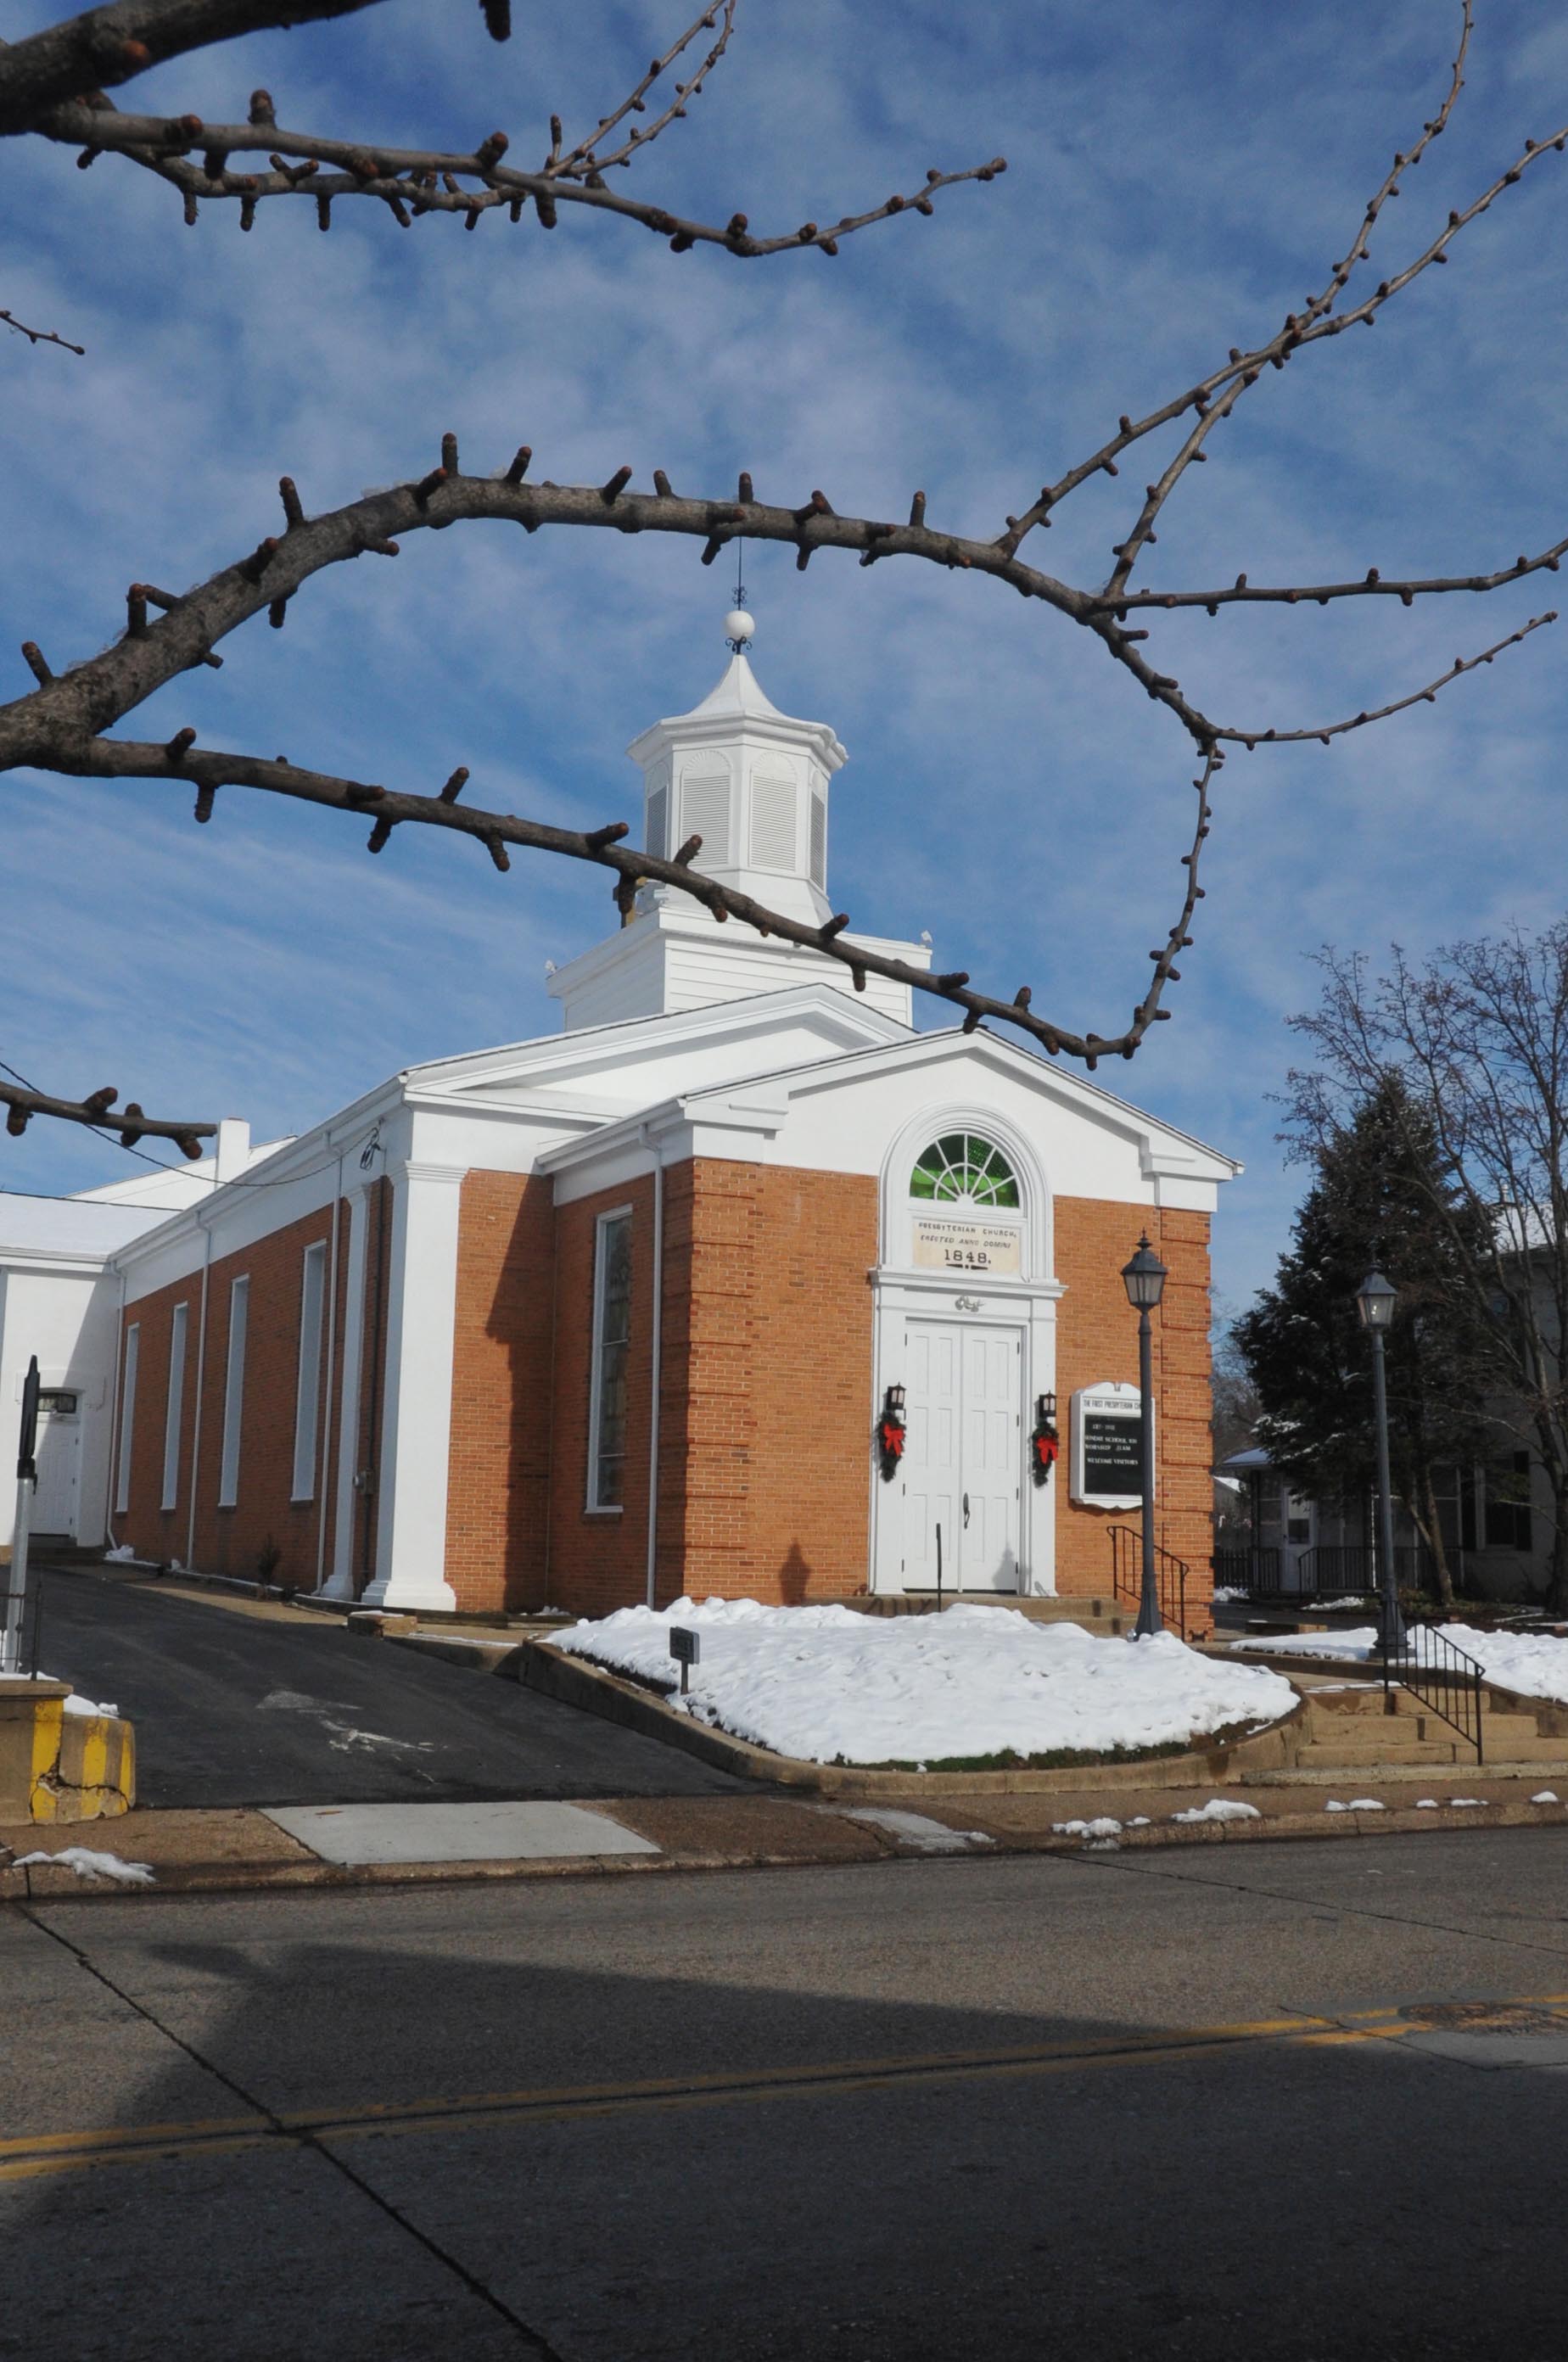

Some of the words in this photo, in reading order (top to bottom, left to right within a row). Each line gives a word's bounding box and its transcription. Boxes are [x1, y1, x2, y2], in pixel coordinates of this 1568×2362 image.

[918, 1222, 976, 1234] PRESBYTERIAN
[921, 1234, 955, 1244] ERECTED
[983, 1240, 1011, 1249] DOMINI
[1093, 1399, 1103, 1408] FIRST
[1105, 1401, 1133, 1410] PRESBYTERIAN
